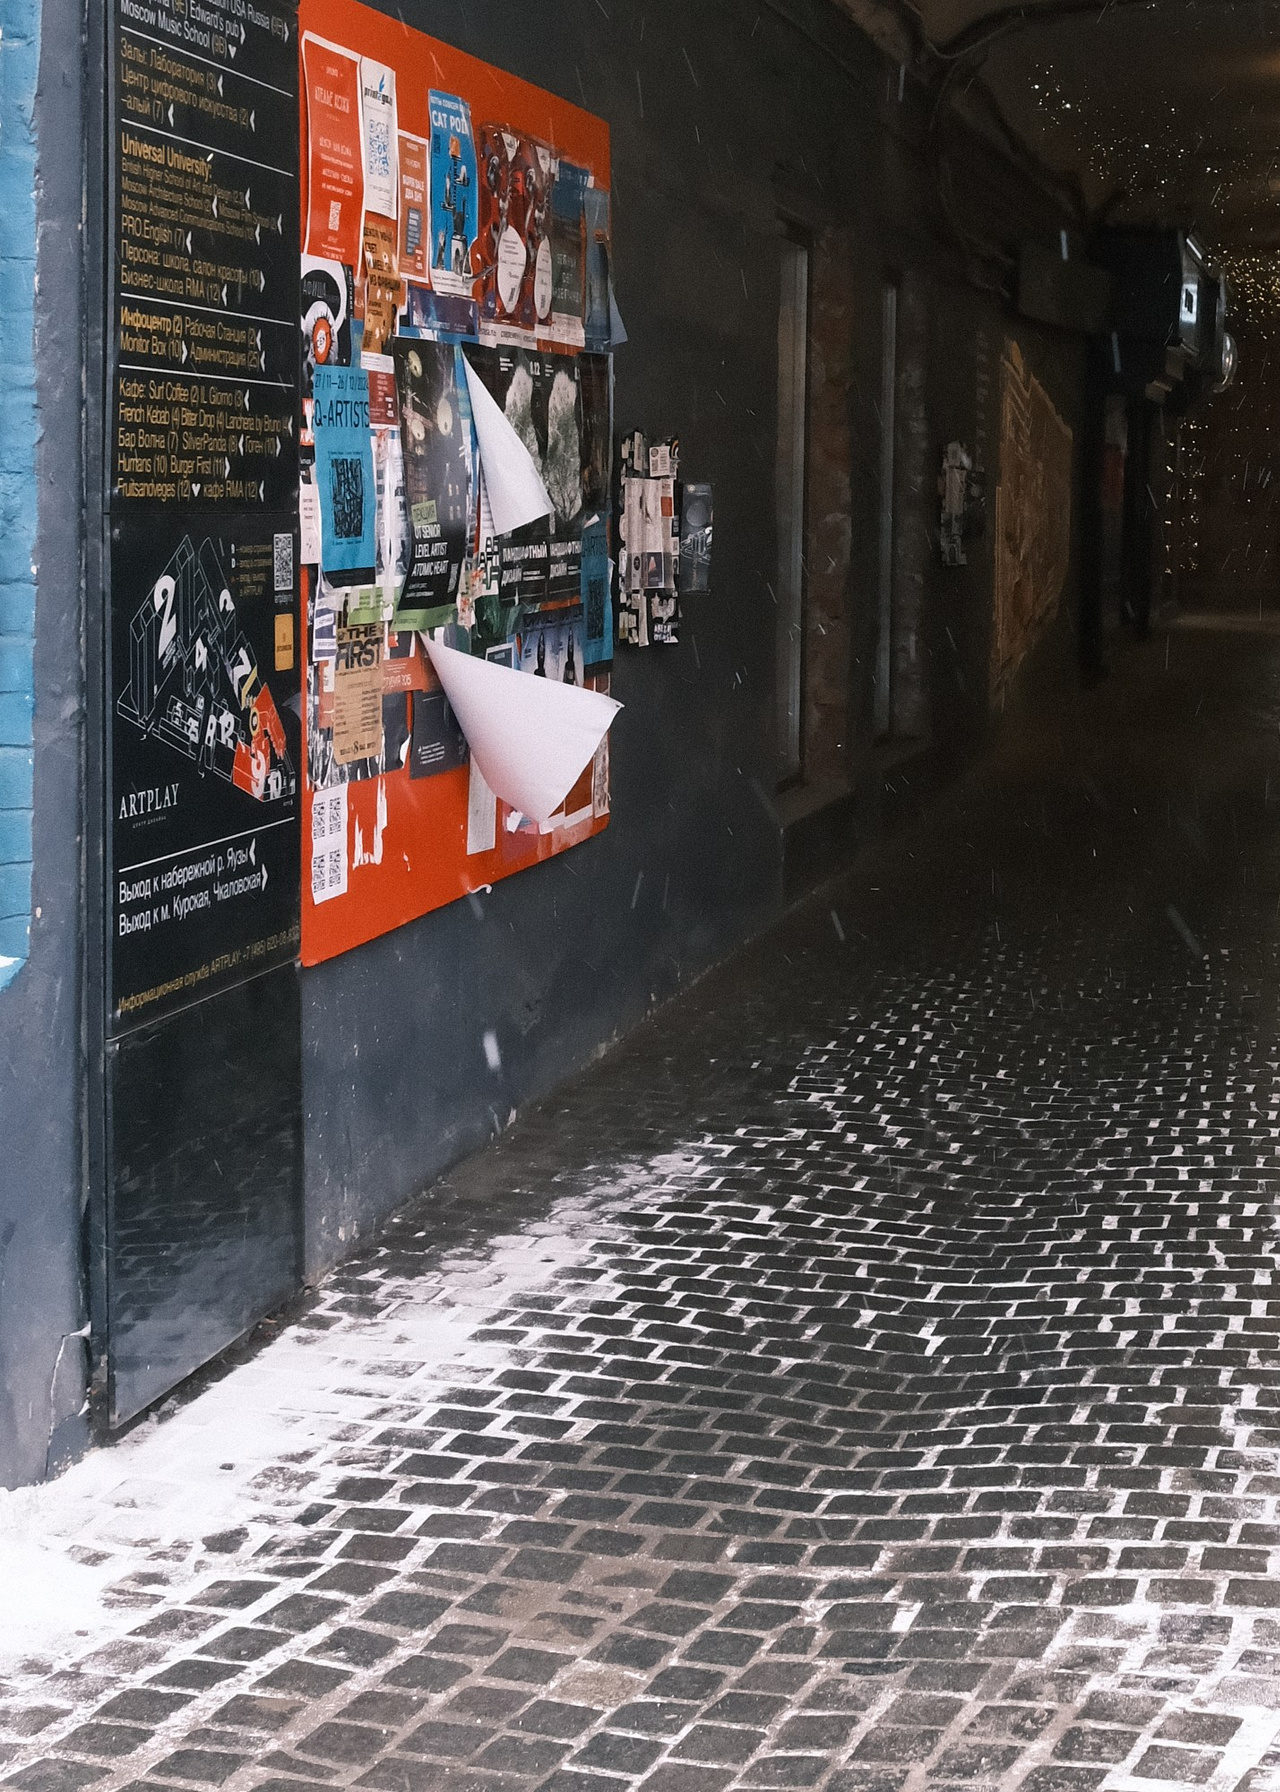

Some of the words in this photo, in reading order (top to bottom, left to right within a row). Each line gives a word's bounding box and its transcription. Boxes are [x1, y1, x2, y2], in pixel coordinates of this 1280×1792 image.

[157, 9, 182, 37] Music
[183, 20, 210, 48] School
[225, 19, 239, 38] pub
[120, 37, 148, 64] Залы:
[150, 49, 204, 86] Лаборатория
[121, 62, 149, 93] Центр
[151, 77, 198, 107] цифрового
[432, 110, 447, 129] CAT
[121, 132, 165, 164] Universal
[166, 146, 212, 182] University:
[121, 239, 160, 266] Персона:
[193, 259, 215, 277] салон
[121, 264, 183, 295] Бизнес-школа
[185, 277, 205, 298] RMA
[120, 305, 171, 336] Инфоцентр
[172, 314, 183, 338] (2)
[184, 316, 216, 339] Рабочая
[217, 322, 246, 346] Станция
[120, 330, 150, 354] Monitor
[151, 335, 167, 357] Box
[189, 341, 246, 368] Администрация
[119, 377, 146, 402] Кафе:
[149, 380, 164, 400] Surf
[165, 381, 189, 402] Coffee
[119, 401, 145, 423] French
[146, 404, 170, 425] Kebab
[199, 409, 215, 432] Drop
[314, 398, 370, 428] Q-ARTISTS
[119, 428, 137, 452] Бар
[138, 428, 165, 449] Волна
[167, 431, 179, 454] (7)
[118, 453, 152, 473] Humans
[170, 455, 195, 478] Burger
[203, 481, 224, 502] кафе
[225, 480, 244, 498] RMA
[415, 543, 430, 559] LEVEL
[430, 542, 448, 558] ARTIST
[411, 561, 434, 577] ATOMIC
[433, 560, 449, 575] HEART
[154, 574, 177, 659] 2
[347, 626, 377, 639] THE
[336, 637, 384, 671] FIRST
[119, 783, 180, 819] ARTPLAY
[119, 881, 151, 904] Выход
[153, 875, 159, 892] к
[161, 853, 216, 889] набережной
[217, 855, 225, 877] р.
[226, 847, 249, 872] Яузы
[119, 913, 151, 936] Выход
[153, 907, 159, 924] к
[161, 904, 171, 922] м.
[173, 889, 211, 921] Курская,
[213, 872, 261, 901] Чкаловская
[118, 975, 184, 1013] Информационная
